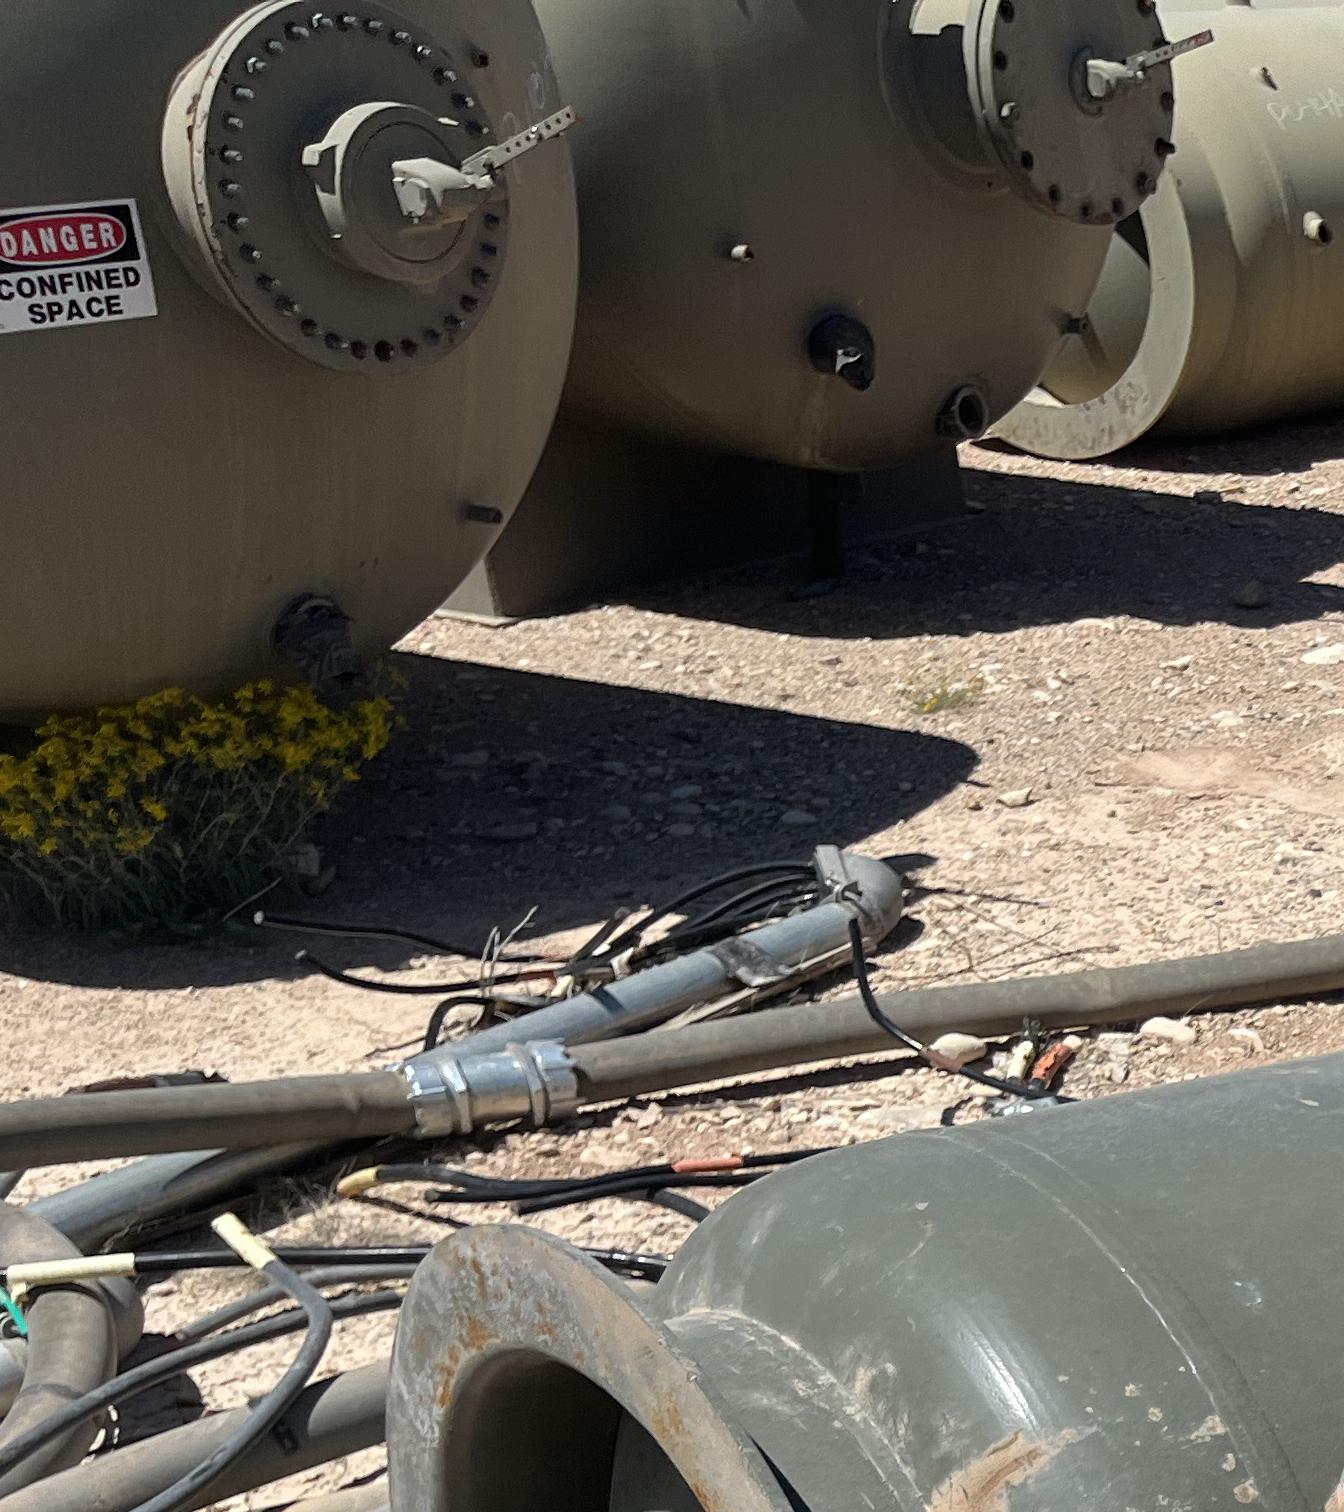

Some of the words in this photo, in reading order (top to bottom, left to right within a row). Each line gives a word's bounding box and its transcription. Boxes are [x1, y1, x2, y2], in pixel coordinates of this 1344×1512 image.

[0, 221, 117, 258] DANGER
[0, 266, 141, 301] CONFINED
[28, 295, 123, 324] SPACE
